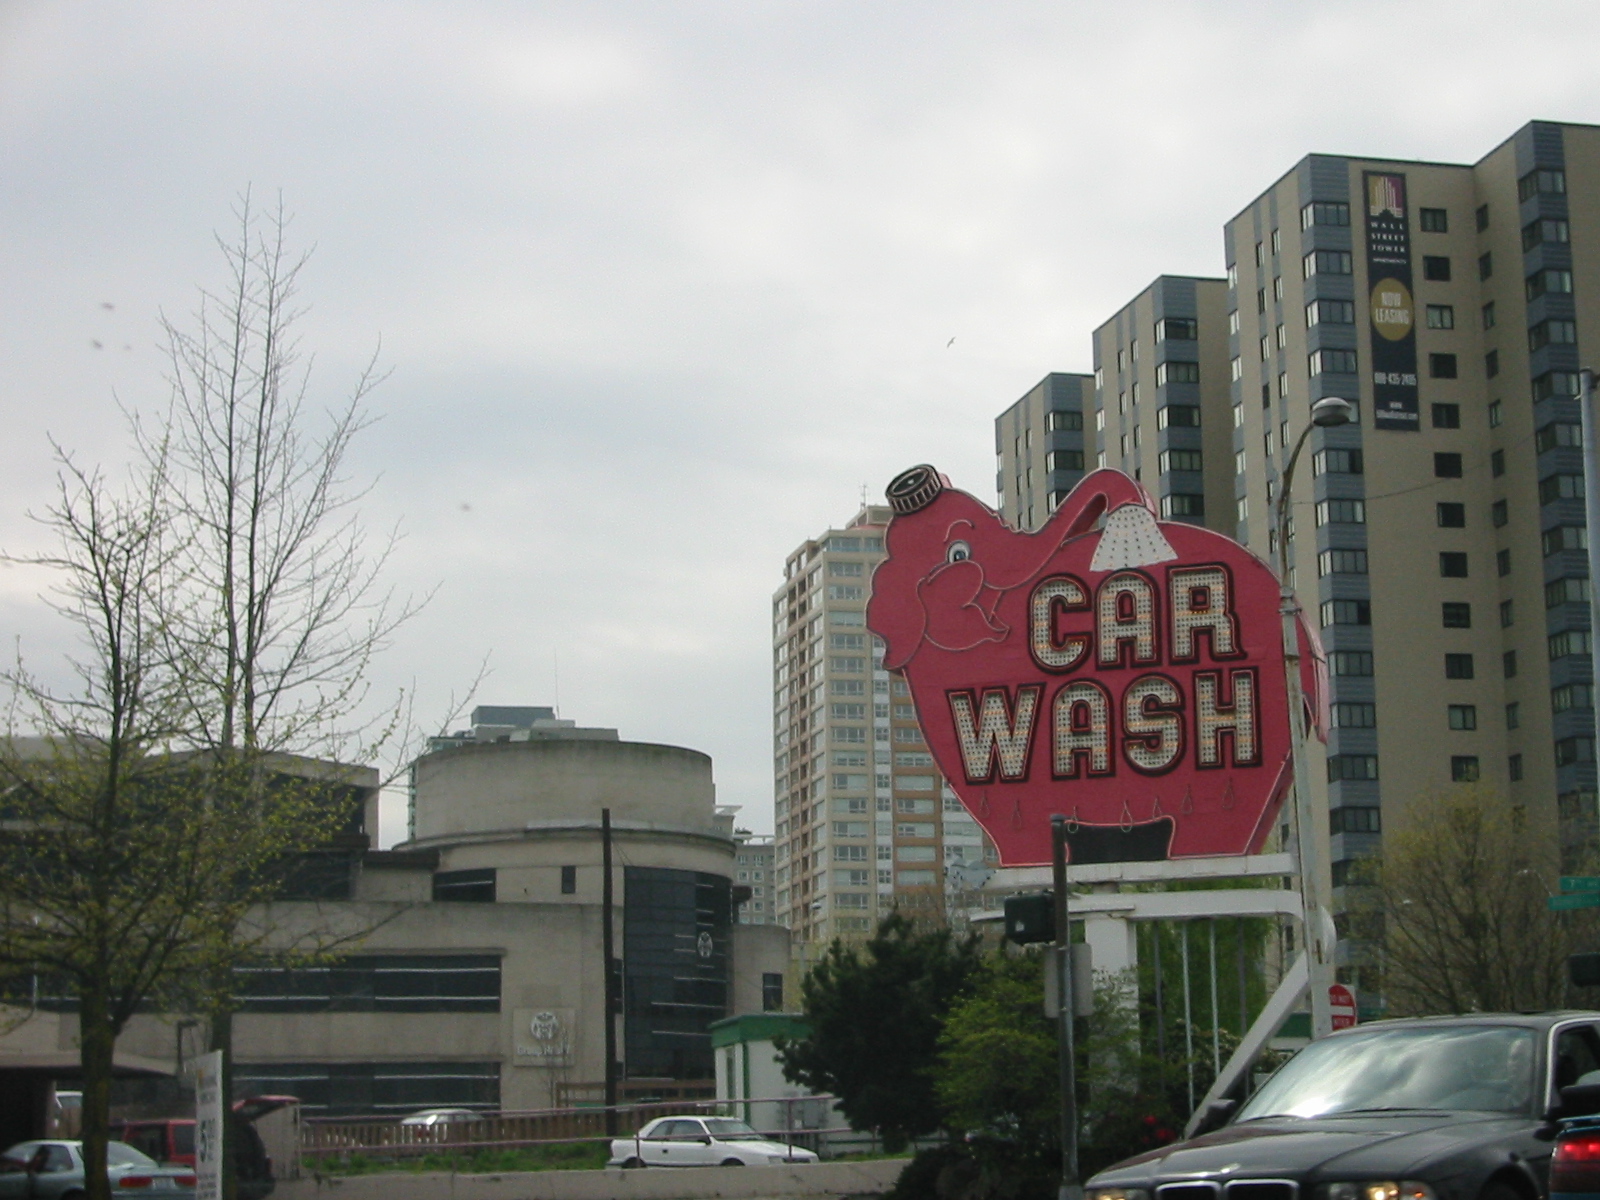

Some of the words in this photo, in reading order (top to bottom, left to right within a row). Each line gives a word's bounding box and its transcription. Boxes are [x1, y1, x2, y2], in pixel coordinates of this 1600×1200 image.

[1371, 221, 1403, 231] WALL
[1371, 232, 1405, 242] STREET
[1372, 244, 1406, 253] TOWER
[1381, 291, 1401, 307] NOW
[1375, 307, 1409, 325] LEASING
[1028, 562, 1248, 675] CAR
[945, 666, 1264, 786] WASH
